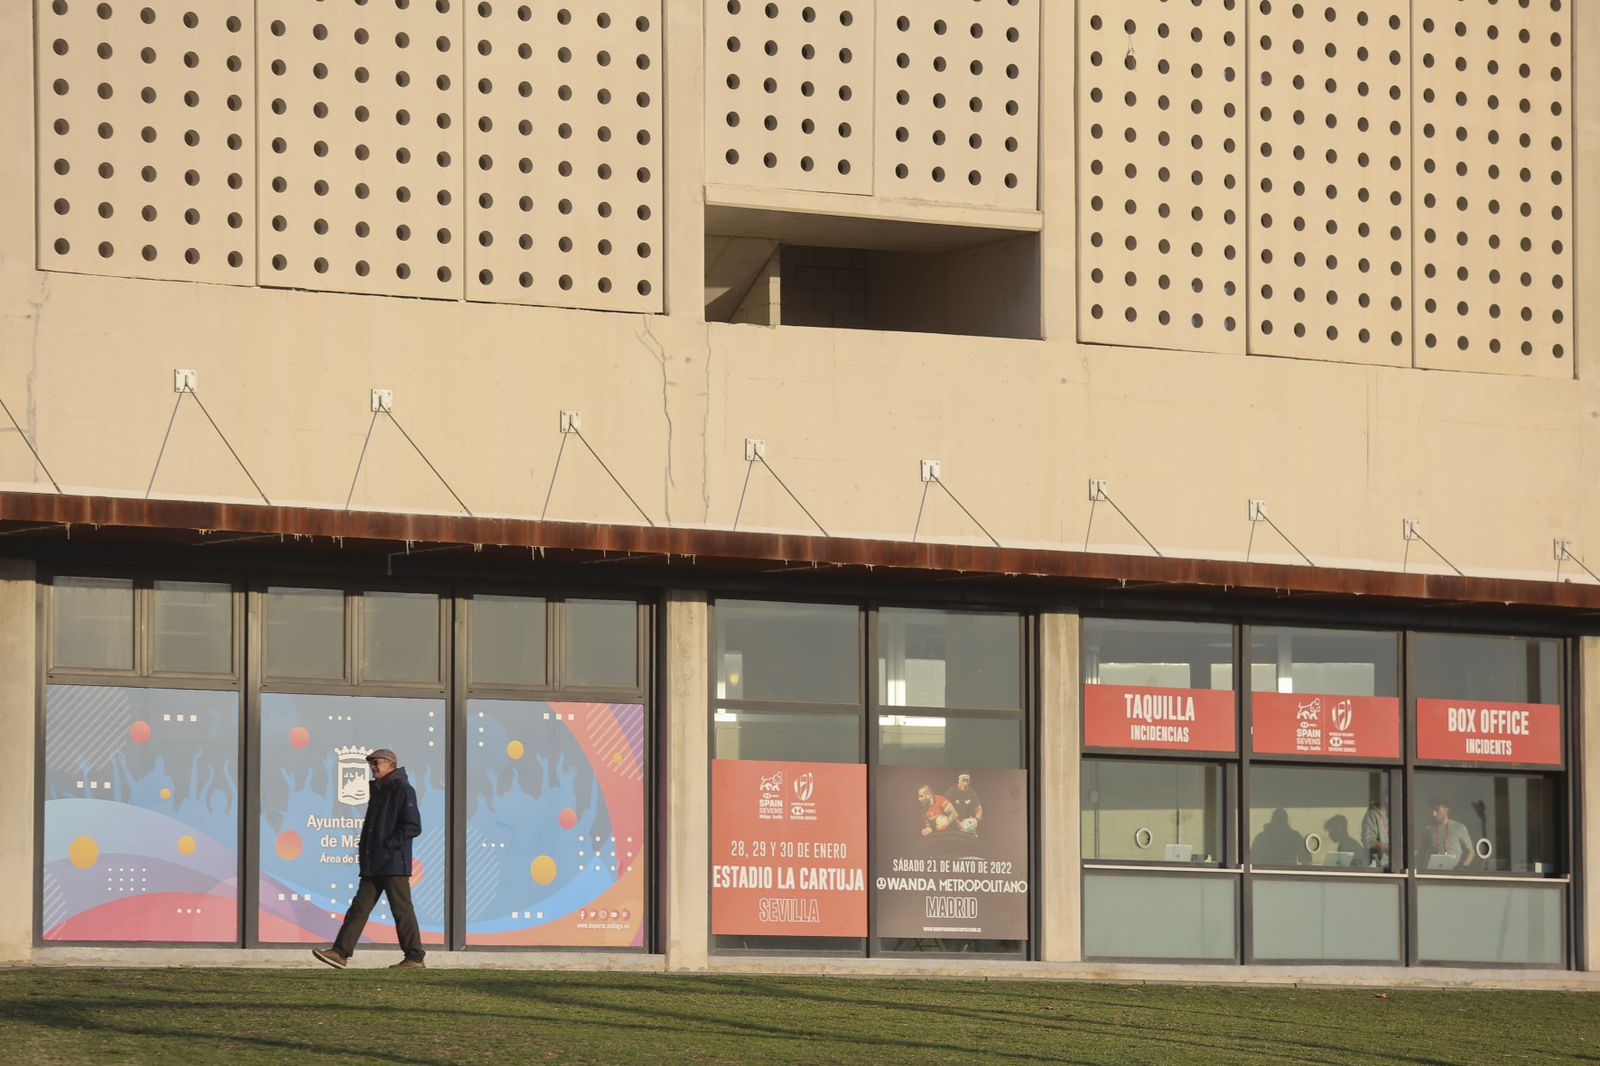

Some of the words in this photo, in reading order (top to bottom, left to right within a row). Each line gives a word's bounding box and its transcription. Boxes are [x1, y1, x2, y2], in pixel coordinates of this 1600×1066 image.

[1124, 693, 1196, 723] TAQUILLA
[1447, 707, 1476, 733] BOX
[1480, 708, 1530, 736] OFFICE
[1130, 724, 1190, 743] INCIDENCIAS
[1296, 728, 1321, 738] SPAIN
[1465, 738, 1512, 756] INCIDENTS
[759, 800, 783, 808] SPAIN
[306, 814, 365, 831] Ayuntam
[320, 834, 338, 848] de
[342, 834, 360, 848] Má
[731, 840, 749, 858] 28,
[752, 840, 766, 857] 29
[770, 841, 777, 857] Y
[780, 841, 794, 858] 30
[797, 842, 810, 858] DE
[814, 842, 847, 859] ENERO
[342, 854, 354, 864] de
[893, 857, 924, 873] SÁBADO
[927, 860, 938, 873] 21
[940, 860, 950, 873] DE
[952, 860, 976, 874] MAYO
[978, 861, 988, 874] DE
[990, 861, 1012, 874] 2022
[713, 865, 773, 889] ESTADIO
[777, 866, 796, 890] LA
[800, 867, 865, 891] CARTUJA
[887, 877, 936, 891] WANDA
[938, 878, 1028, 893] METROPOLITANO
[759, 897, 820, 923] SEVILLA
[926, 896, 978, 918] MADRID
